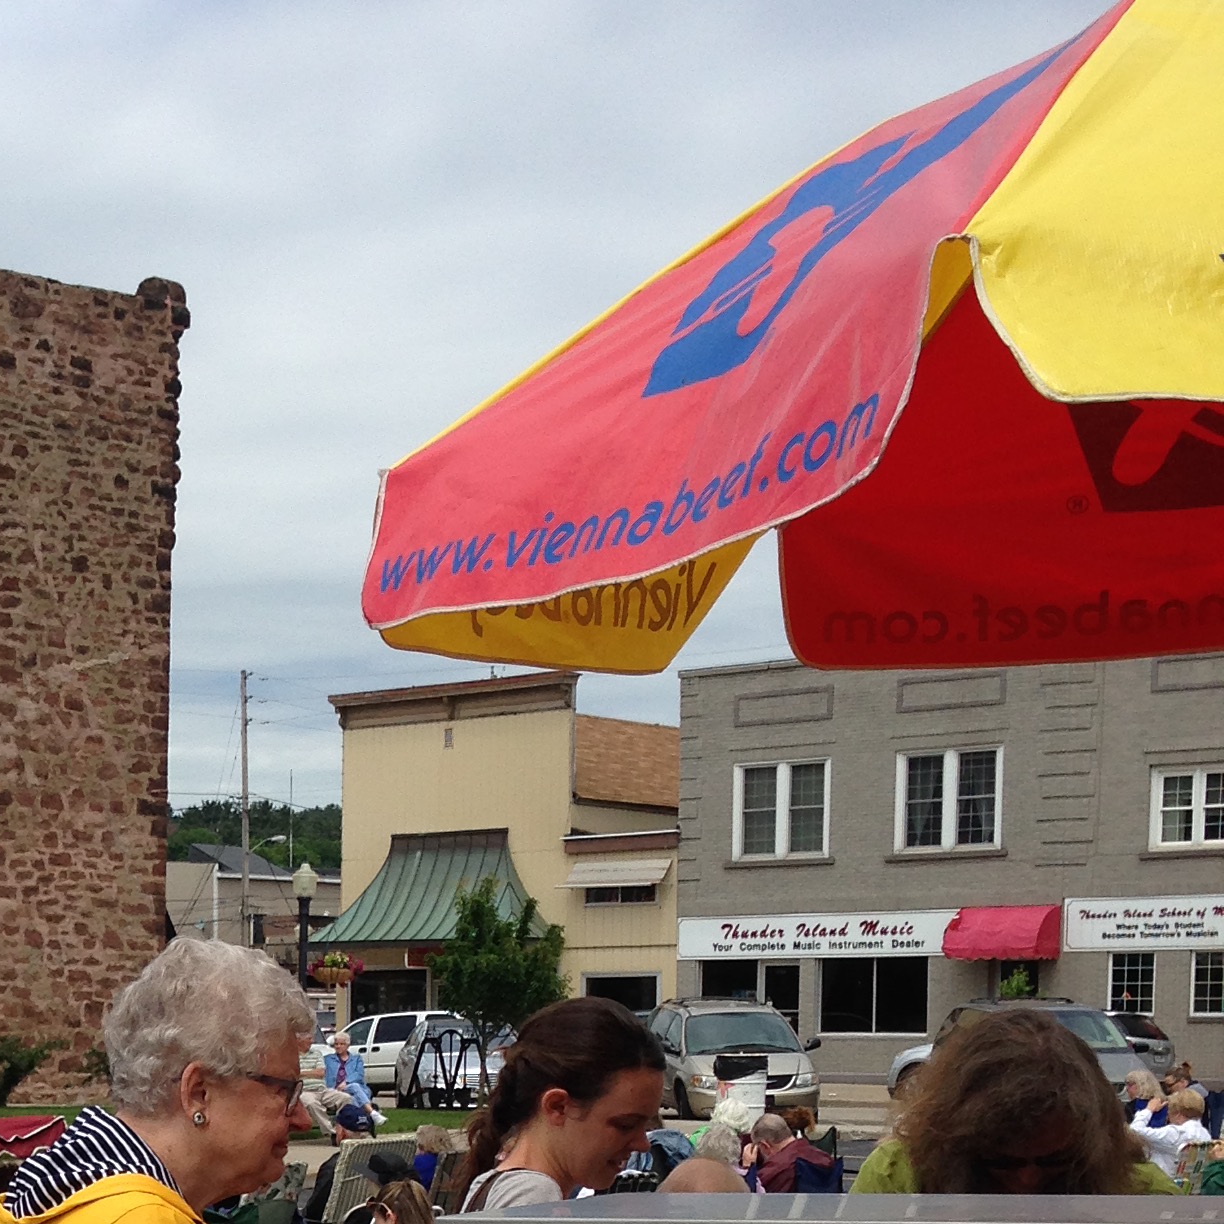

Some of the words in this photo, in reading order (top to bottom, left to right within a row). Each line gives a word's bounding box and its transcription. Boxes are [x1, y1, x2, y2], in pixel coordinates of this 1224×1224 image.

[380, 393, 879, 593] www.viennabeef.com
[1079, 909, 1117, 920] Thunder
[1123, 908, 1154, 918] Island
[1159, 907, 1193, 918] School
[1196, 907, 1207, 919] of
[720, 923, 784, 940] Thunder
[796, 922, 849, 938] Island
[859, 920, 914, 936] Music
[712, 943, 733, 952] Your
[739, 941, 786, 952] Complete
[793, 940, 821, 950] Music
[828, 940, 884, 950] Instrument
[891, 939, 925, 949] Dealer
